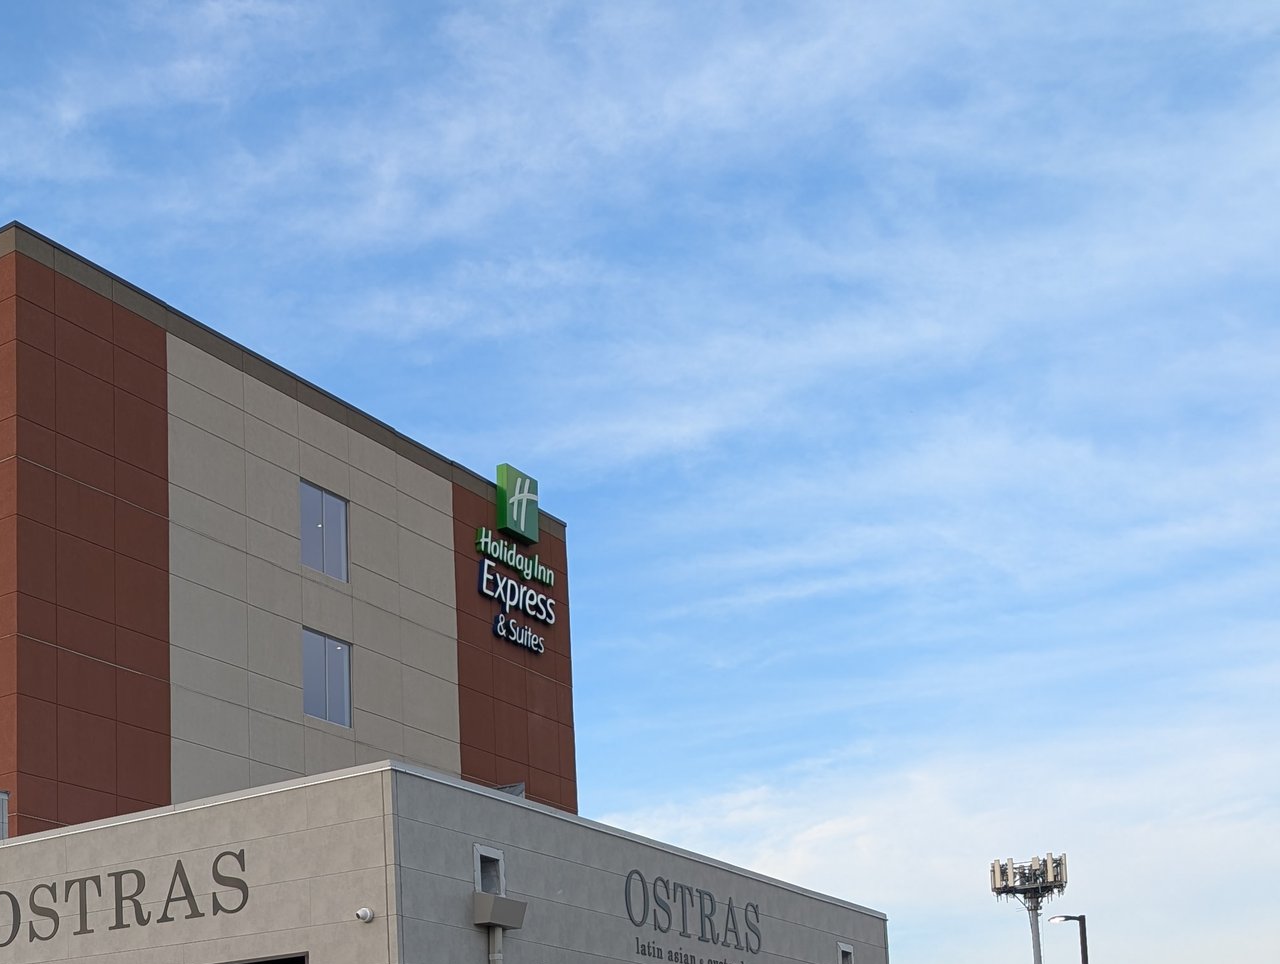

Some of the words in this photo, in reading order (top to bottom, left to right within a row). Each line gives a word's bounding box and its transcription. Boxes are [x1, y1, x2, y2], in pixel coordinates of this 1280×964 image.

[479, 526, 533, 580] Holiday
[534, 554, 554, 587] Inn
[482, 559, 556, 625] Express
[496, 613, 507, 638] &
[508, 619, 545, 653] Suites
[624, 869, 762, 955] OSTRAS
[635, 936, 663, 960] latin
